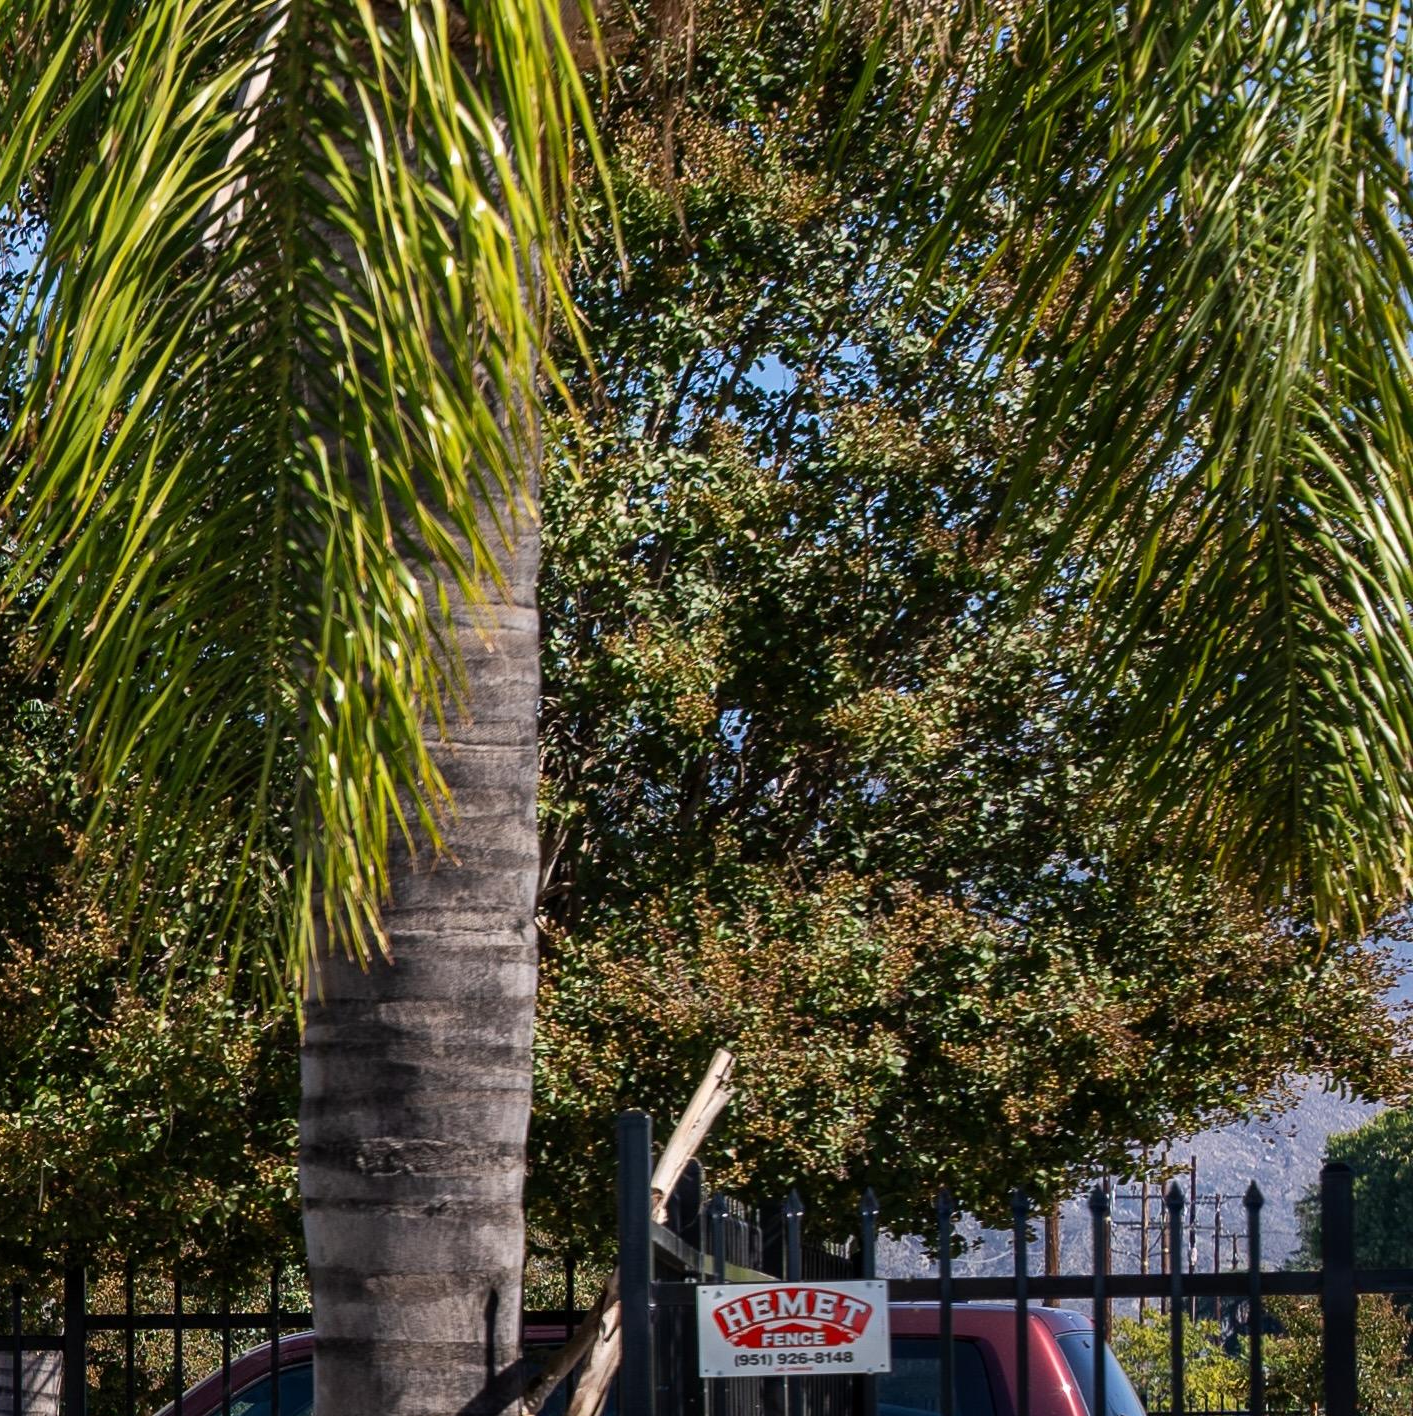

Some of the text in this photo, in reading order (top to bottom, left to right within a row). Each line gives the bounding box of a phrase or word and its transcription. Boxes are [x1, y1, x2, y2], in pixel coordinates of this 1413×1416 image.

[718, 1291, 866, 1334] HEMET
[761, 1332, 826, 1346] FENCE
[734, 1351, 854, 1367] (951) 926-8148
